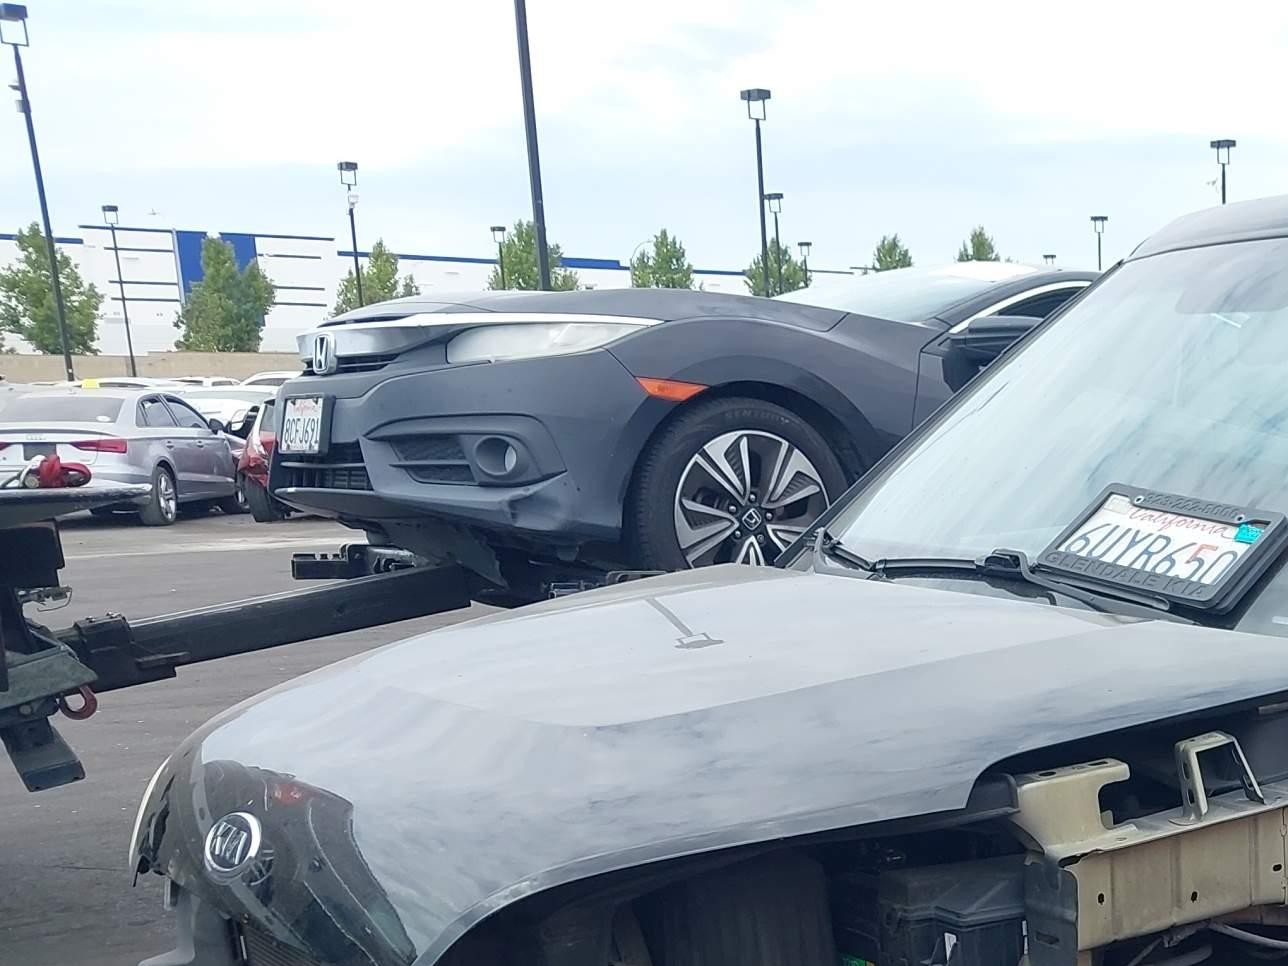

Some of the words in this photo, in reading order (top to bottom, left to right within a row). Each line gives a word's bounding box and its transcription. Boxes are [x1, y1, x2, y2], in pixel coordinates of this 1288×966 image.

[1129, 506, 1235, 540] California
[1044, 551, 1161, 588] GLENDALE
[1162, 577, 1207, 597] KIA
